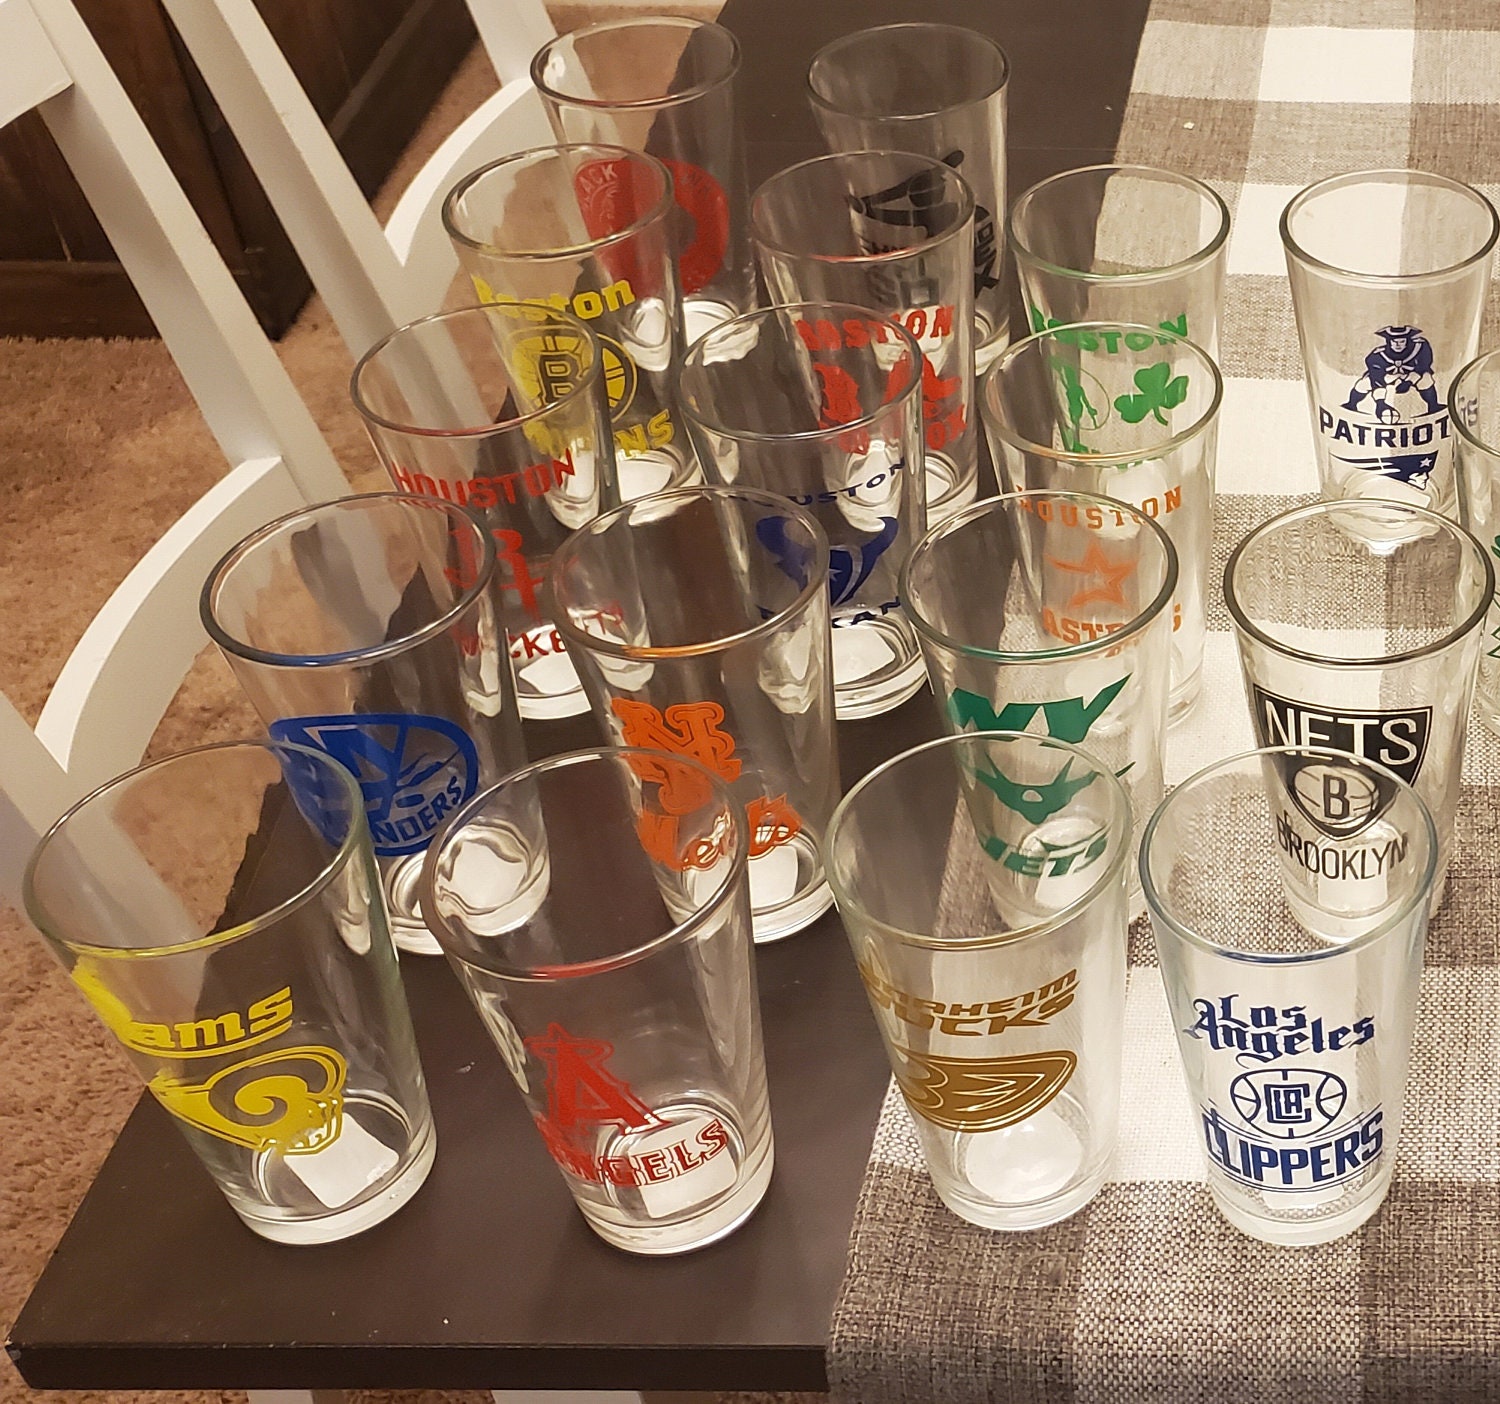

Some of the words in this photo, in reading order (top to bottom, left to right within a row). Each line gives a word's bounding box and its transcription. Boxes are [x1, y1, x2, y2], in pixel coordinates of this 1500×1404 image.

[1265, 700, 1417, 765] NETS
[1323, 774, 1350, 819] B
[1276, 810, 1409, 880] BROOKLYN
[1183, 998, 1375, 1069] Angeles
[1218, 994, 1307, 1033] Los
[1202, 1108, 1384, 1184] CLIPPERS
